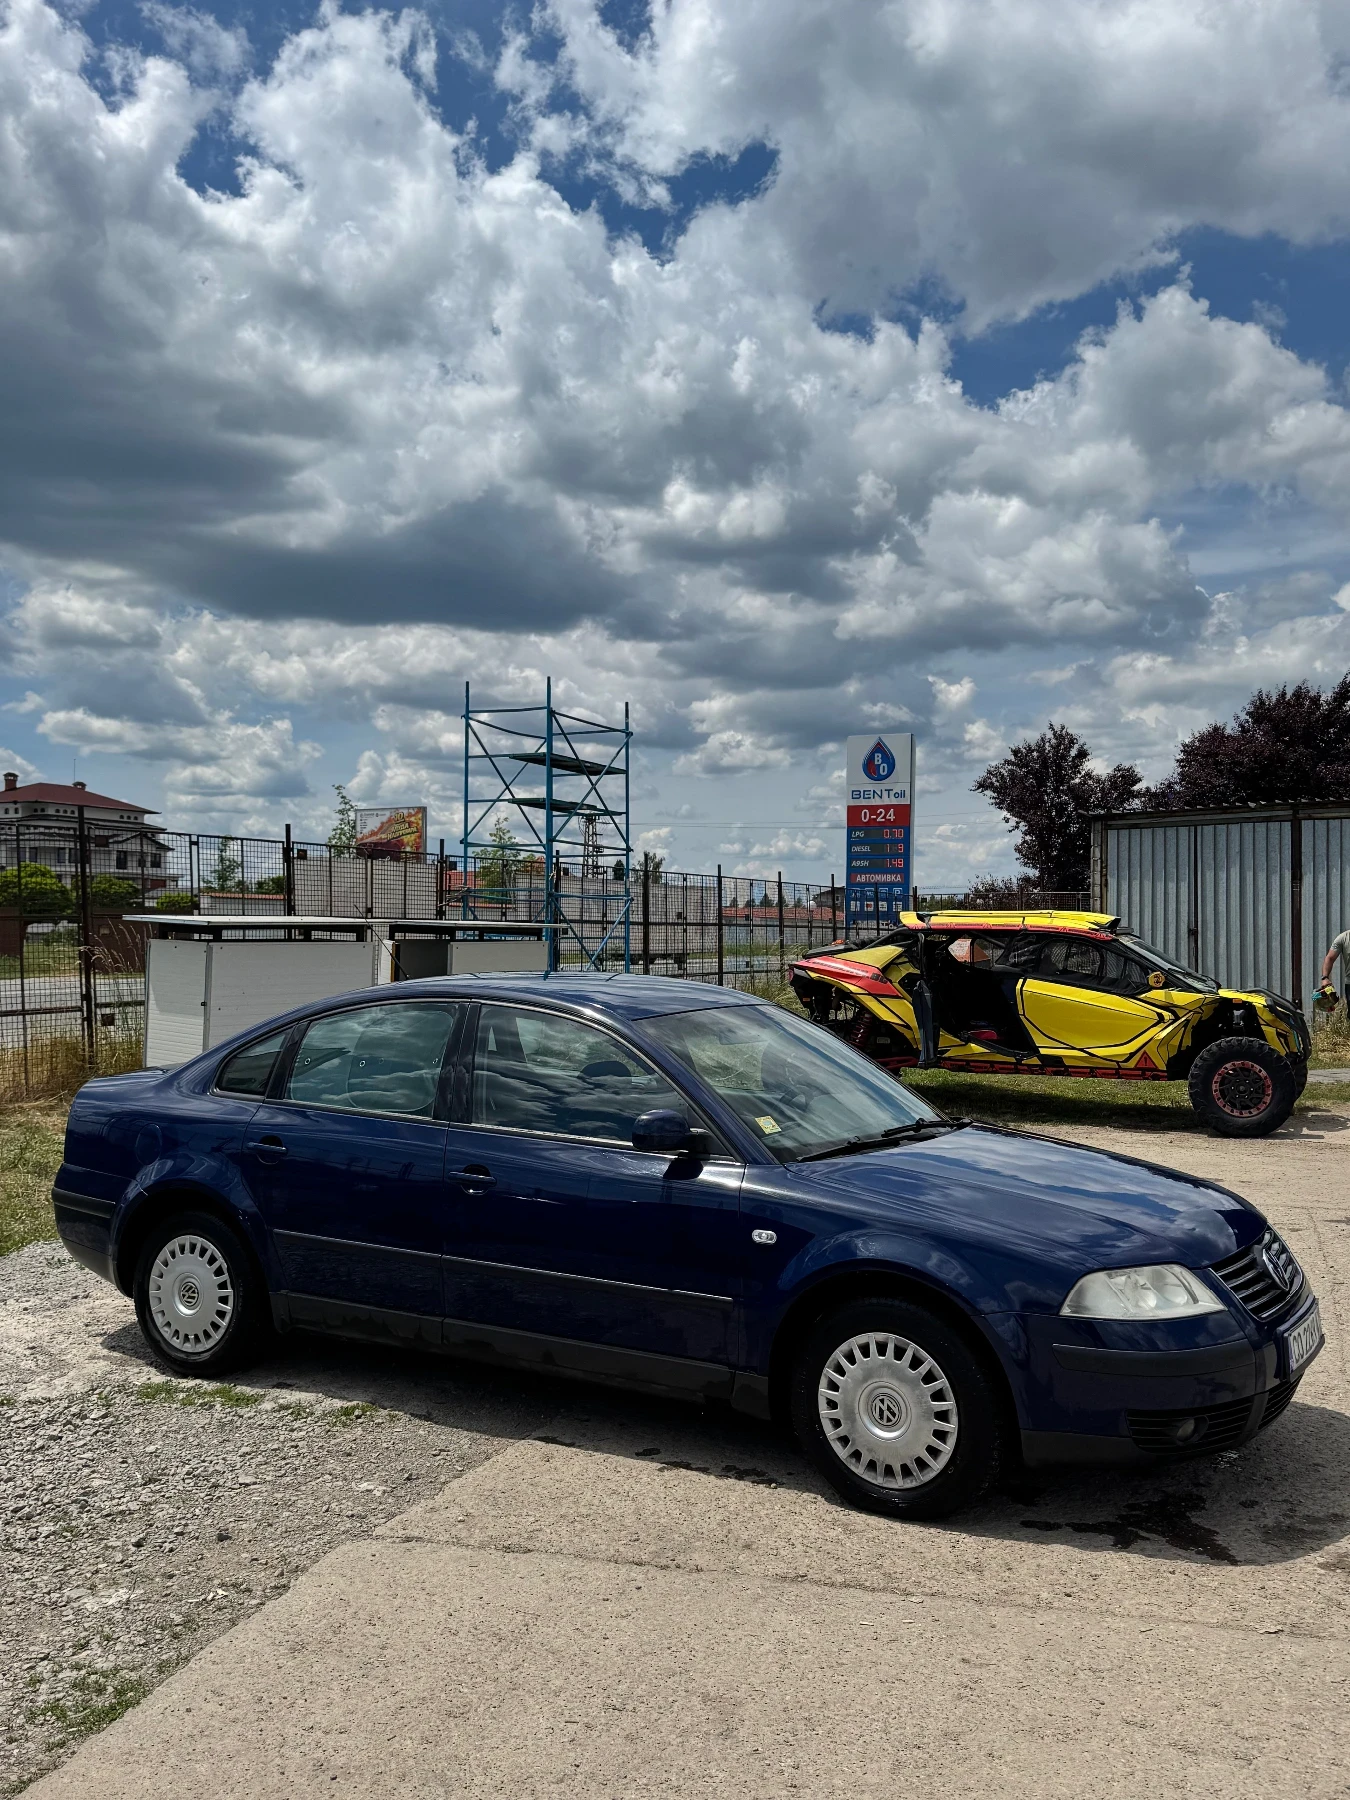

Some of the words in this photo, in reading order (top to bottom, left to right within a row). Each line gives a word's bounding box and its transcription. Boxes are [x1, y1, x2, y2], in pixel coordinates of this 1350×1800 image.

[861, 808, 896, 823] 0-24
[883, 828, 904, 839] 0.70
[886, 858, 904, 868] 1.49
[856, 873, 902, 882] АВТОМИВКА
